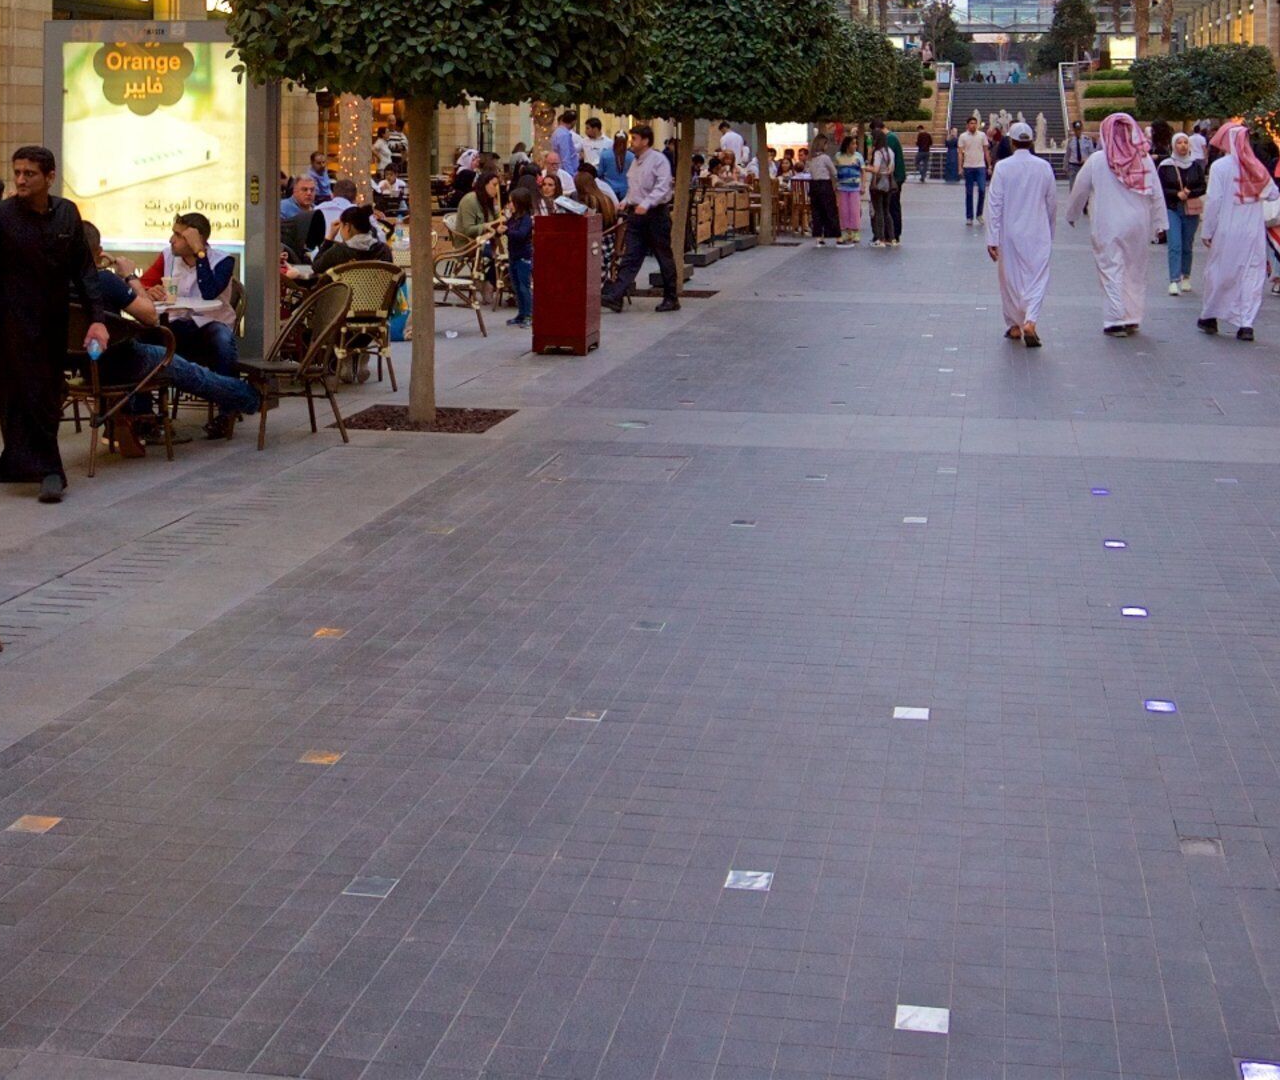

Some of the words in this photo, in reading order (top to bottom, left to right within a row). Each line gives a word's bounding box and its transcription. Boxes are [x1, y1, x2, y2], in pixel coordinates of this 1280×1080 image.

[106, 51, 181, 74] Orange
[123, 75, 164, 98] فايبر
[195, 199, 240, 213] Orange
